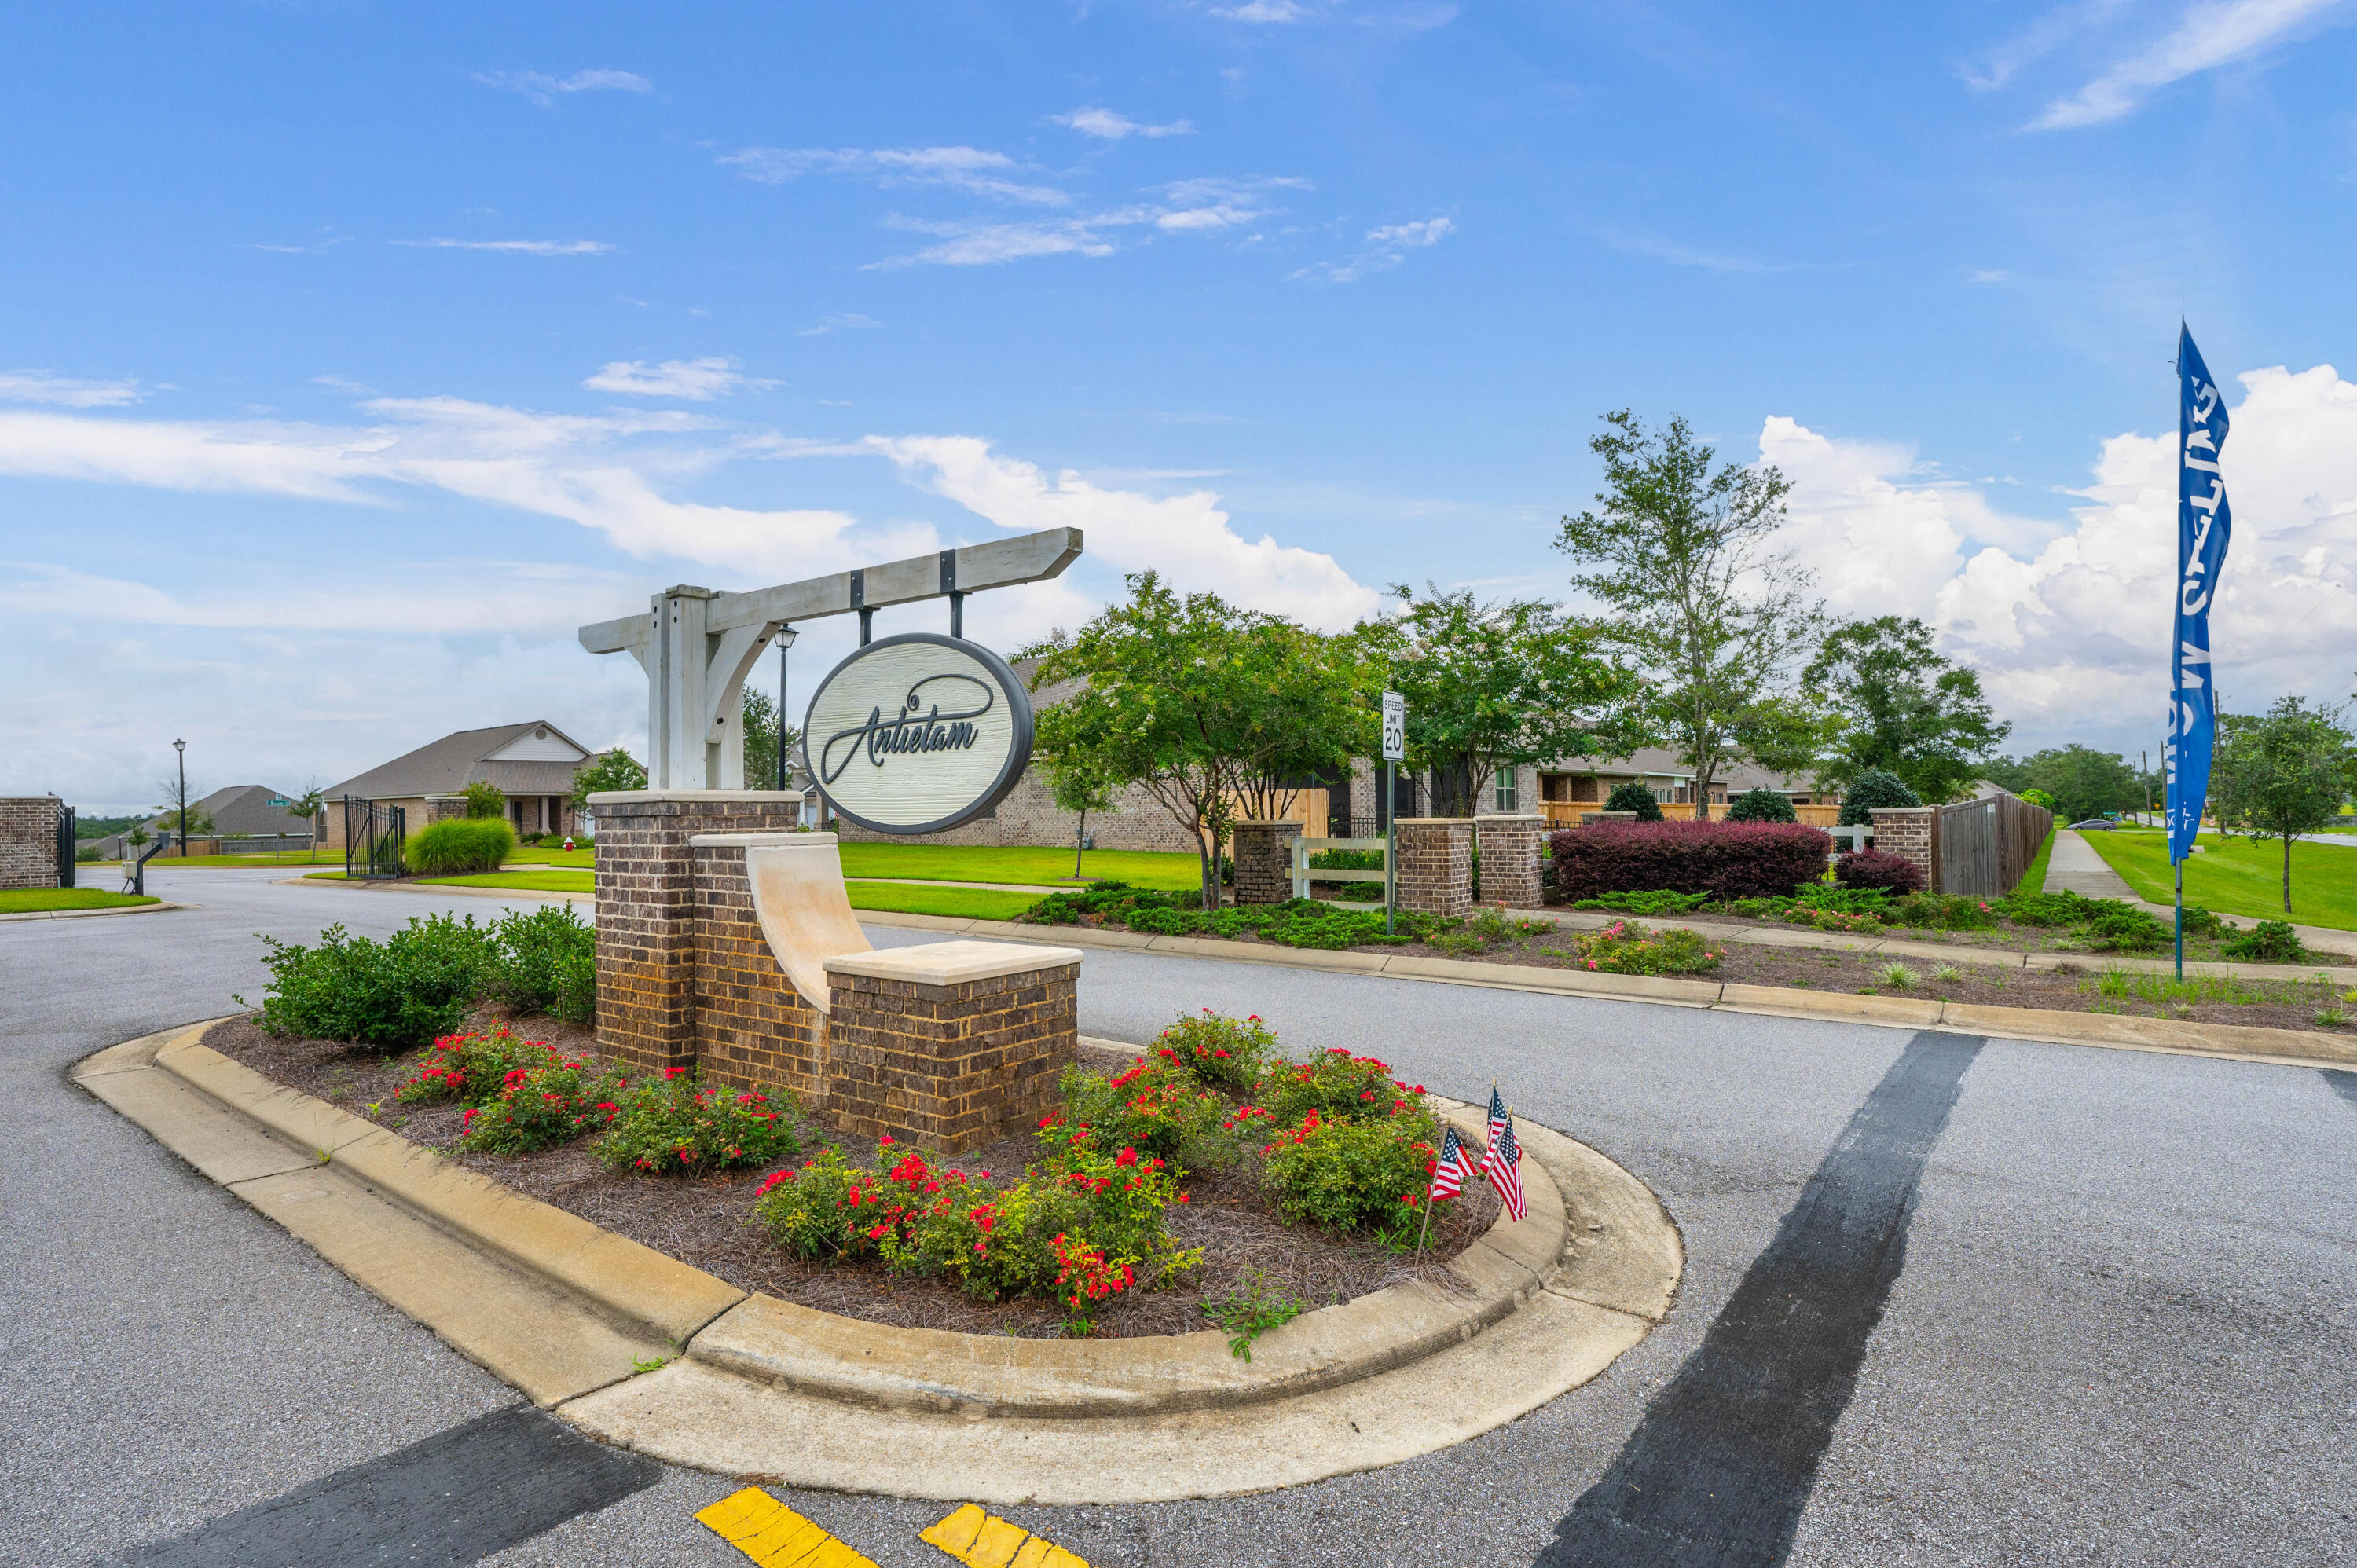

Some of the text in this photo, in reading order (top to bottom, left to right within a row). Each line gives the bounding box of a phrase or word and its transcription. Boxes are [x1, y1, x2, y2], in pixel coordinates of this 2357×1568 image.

[1384, 699, 1402, 712] SPEED
[1386, 713, 1400, 724] LIMIT
[1385, 727, 1402, 752] 20
